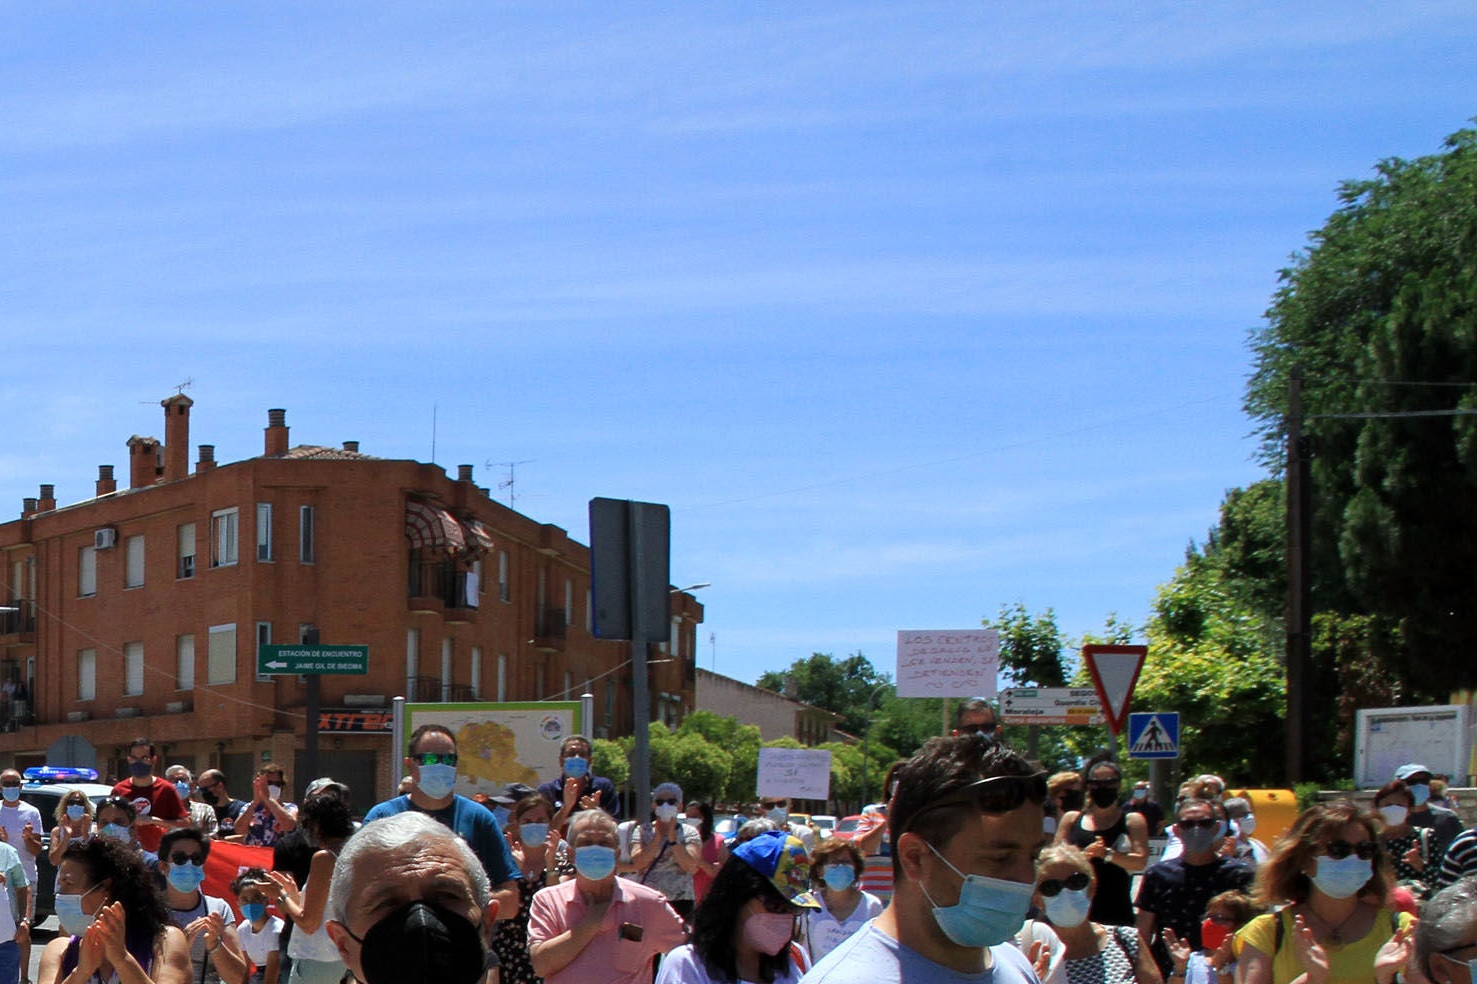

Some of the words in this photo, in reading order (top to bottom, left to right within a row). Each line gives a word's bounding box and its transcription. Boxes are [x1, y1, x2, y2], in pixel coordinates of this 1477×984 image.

[904, 635, 933, 645] LOS
[321, 650, 363, 658] ENCUENTRO
[294, 662, 314, 670] JAIME
[326, 662, 336, 670] DE
[337, 662, 363, 670] BIEDMA
